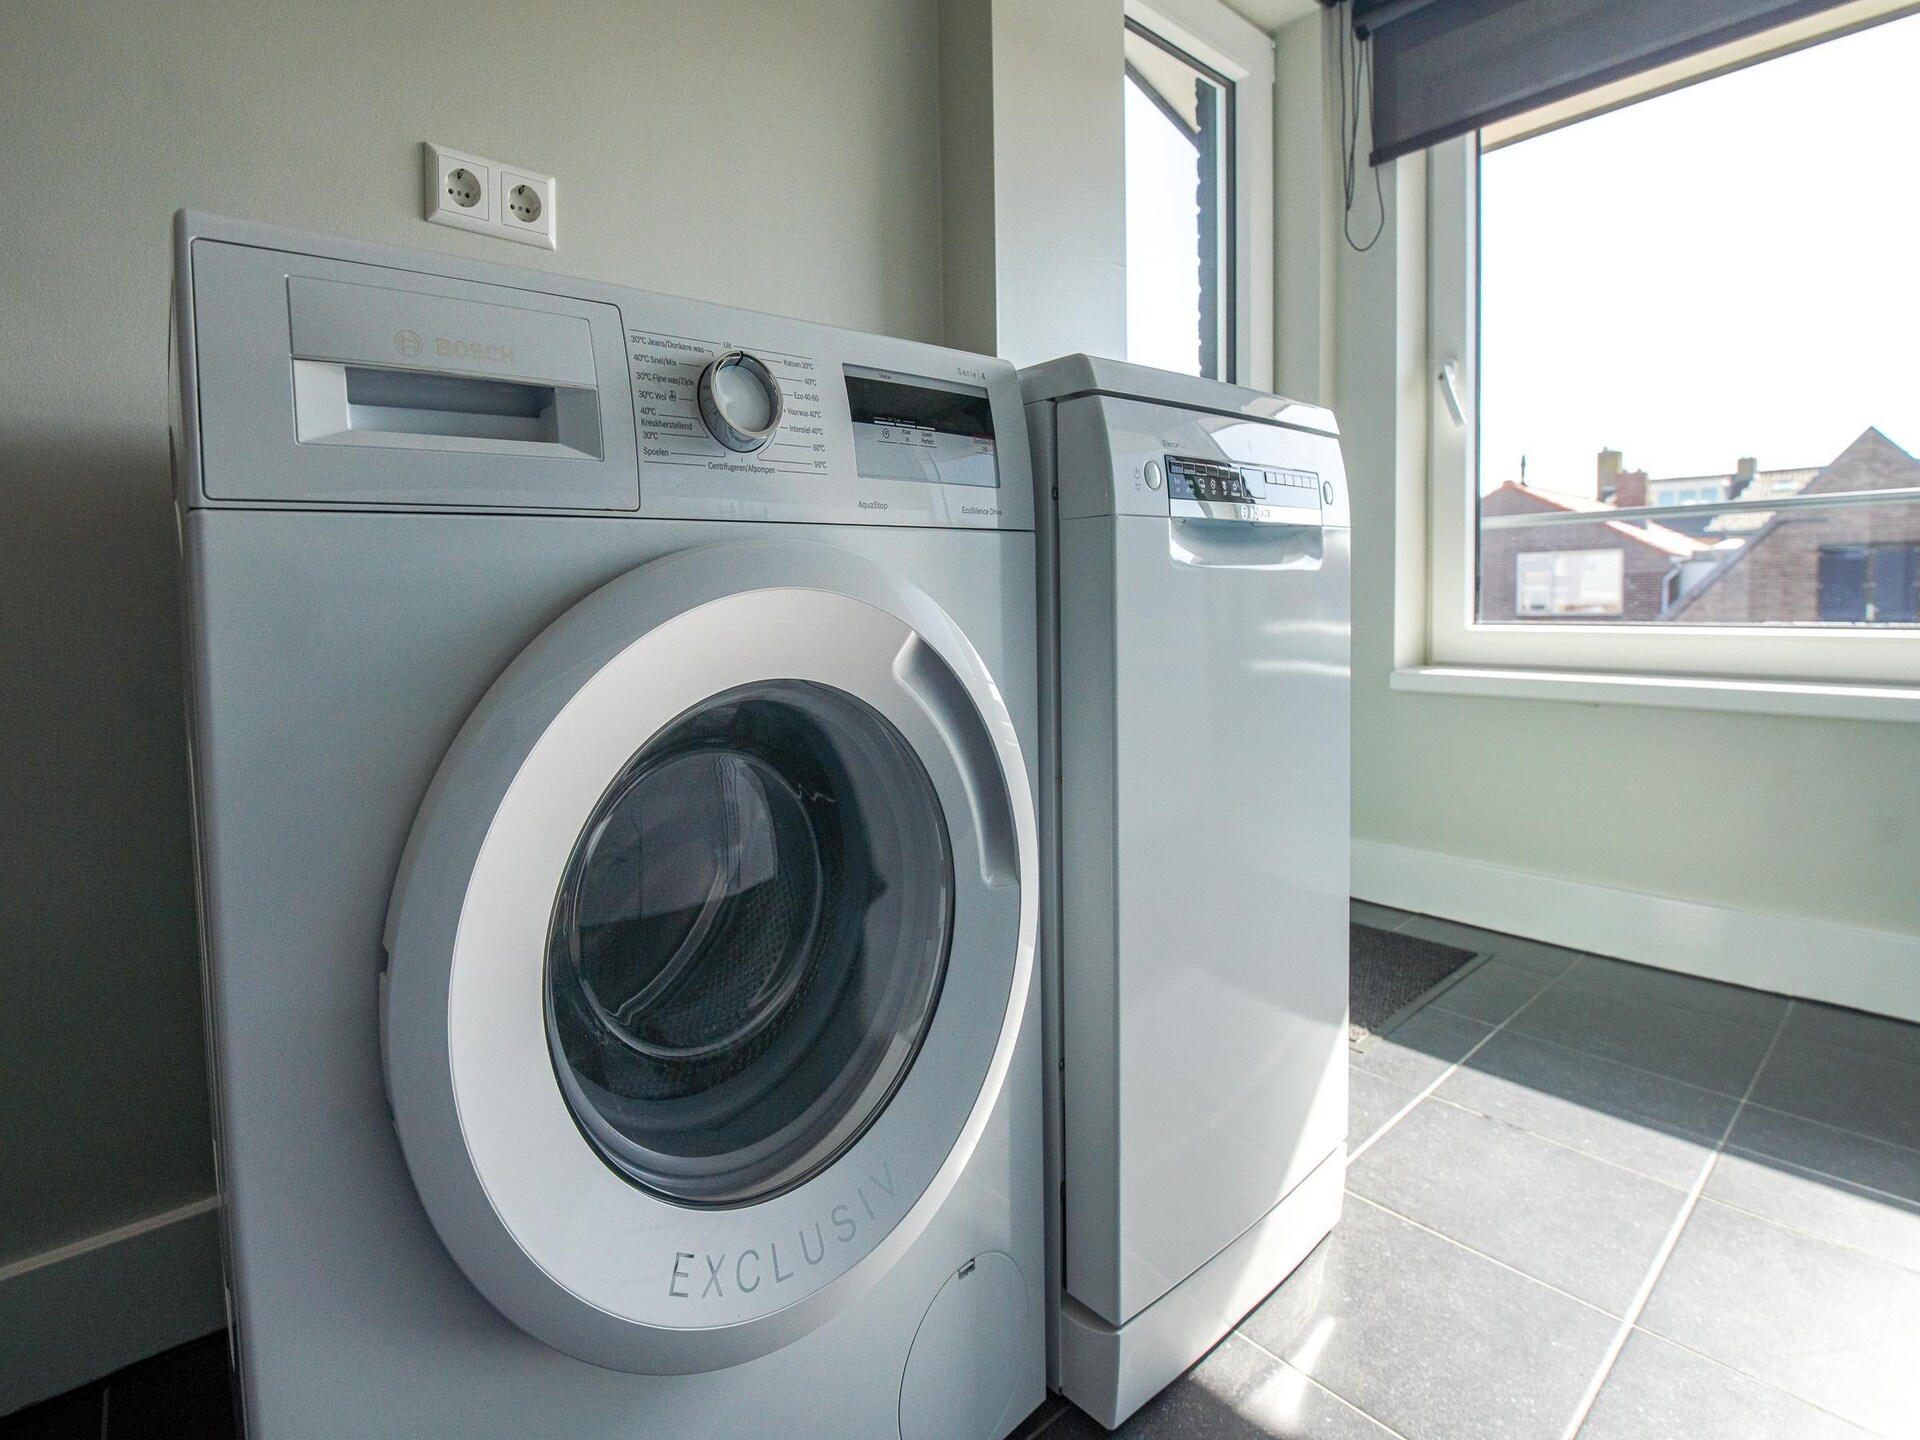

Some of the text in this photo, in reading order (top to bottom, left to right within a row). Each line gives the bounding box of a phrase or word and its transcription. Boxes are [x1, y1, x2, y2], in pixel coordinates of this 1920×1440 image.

[648, 338, 692, 352] Jeans/Donkere
[784, 359, 800, 368] Katoen
[654, 392, 668, 400] Wol
[794, 392, 804, 400] Eco
[786, 406, 809, 417] Voorwas
[640, 418, 692, 430] Kreukherstellend
[644, 446, 670, 456] Spoelen
[708, 461, 776, 474] Centrifugeren/Afpompen
[858, 500, 888, 511] AquaStop
[962, 506, 1002, 516] EcoSilence Drive
[668, 1160, 897, 1299] EXCLUSIV
